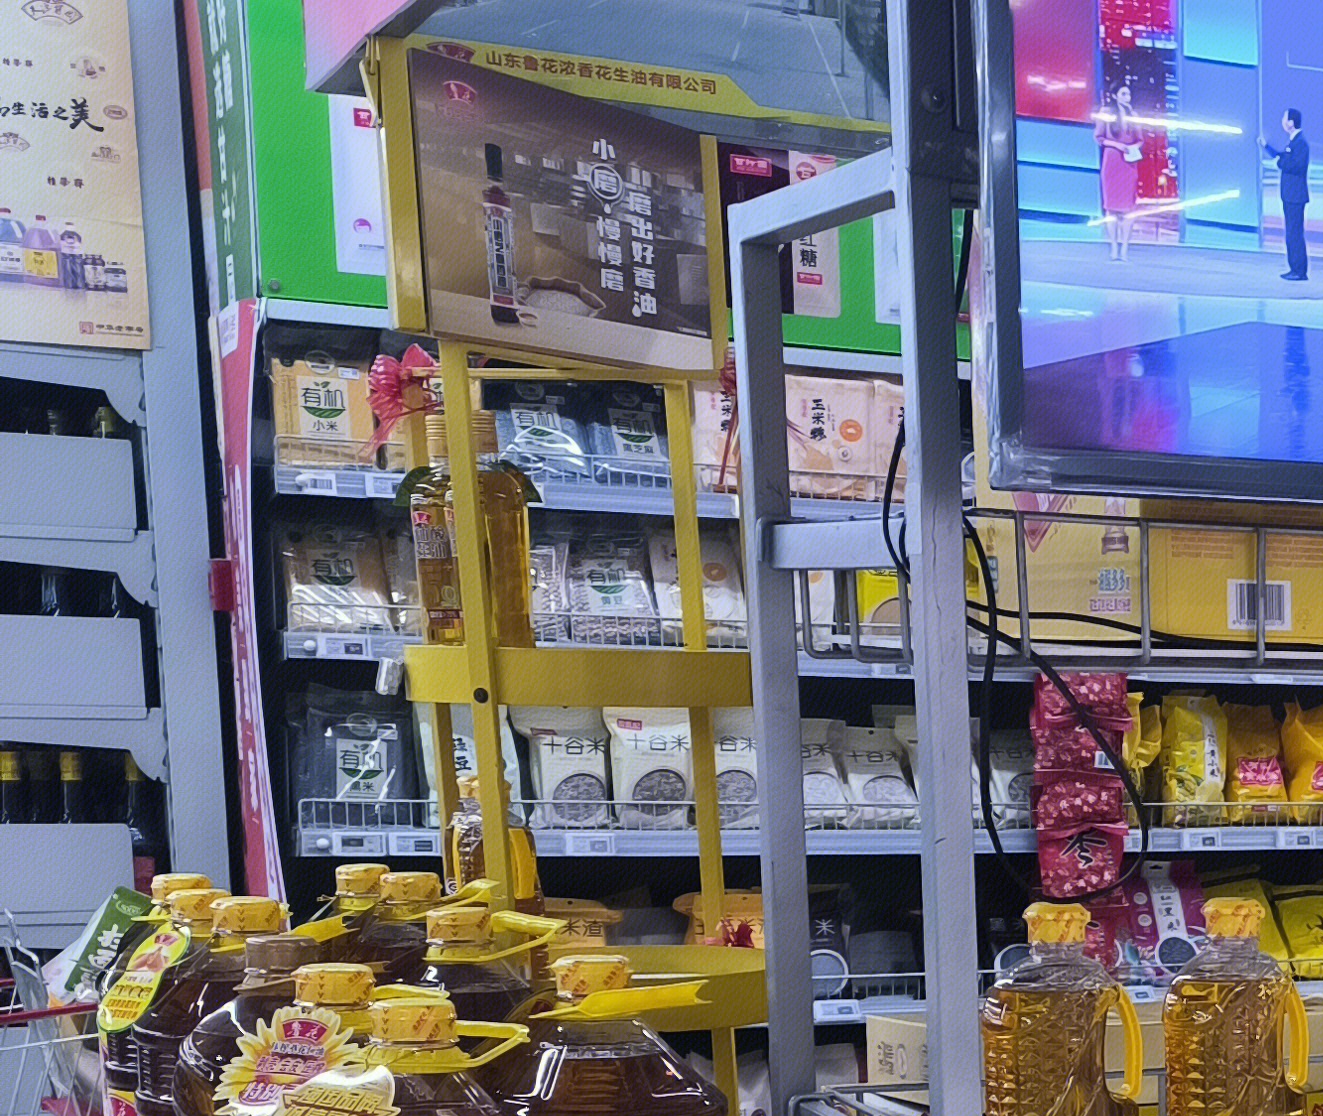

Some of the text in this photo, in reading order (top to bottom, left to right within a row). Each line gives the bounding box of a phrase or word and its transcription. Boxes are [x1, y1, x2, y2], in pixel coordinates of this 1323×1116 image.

[485, 49, 718, 96] 山东鲁花浓香花生油有限公司
[300, 386, 348, 411] 有机
[311, 419, 340, 433] 小米
[513, 407, 561, 432] 有机
[610, 413, 656, 438] 有机
[310, 555, 358, 580] 有机
[541, 736, 607, 758] 十谷米
[625, 734, 691, 754] 十谷米
